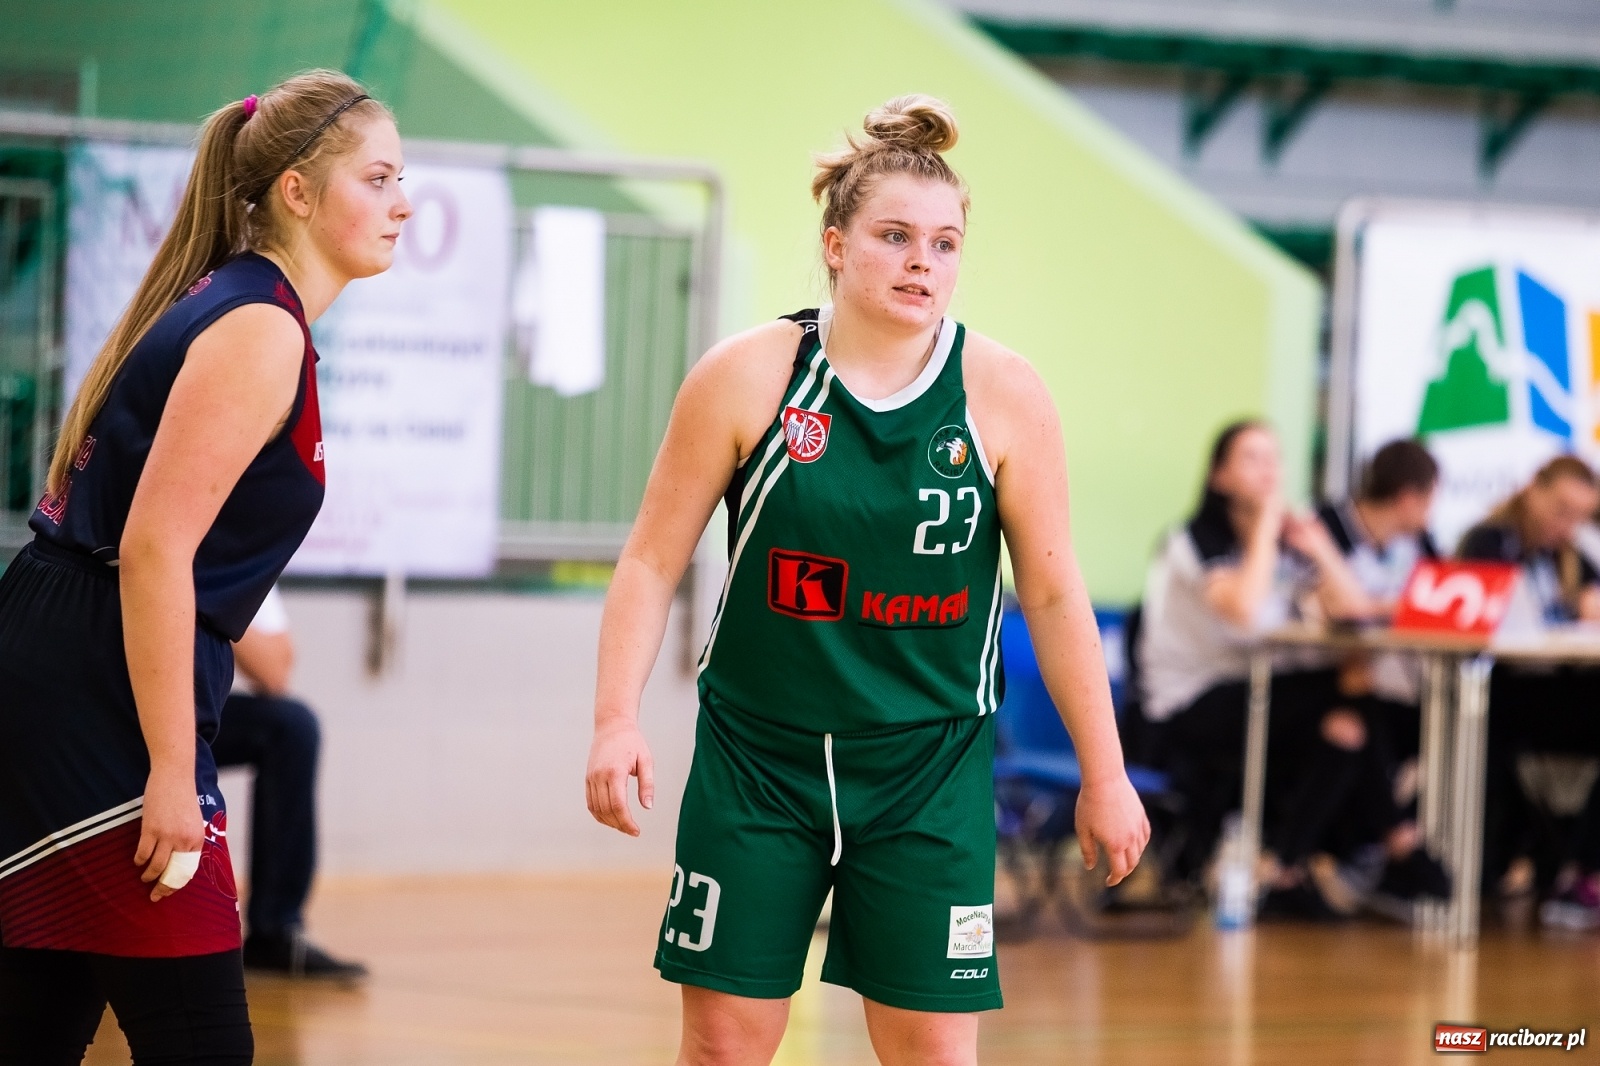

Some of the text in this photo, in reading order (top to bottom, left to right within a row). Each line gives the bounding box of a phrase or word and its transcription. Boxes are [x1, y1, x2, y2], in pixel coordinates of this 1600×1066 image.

[912, 486, 982, 555] 23
[773, 556, 837, 613] K
[950, 968, 989, 979] COLO
